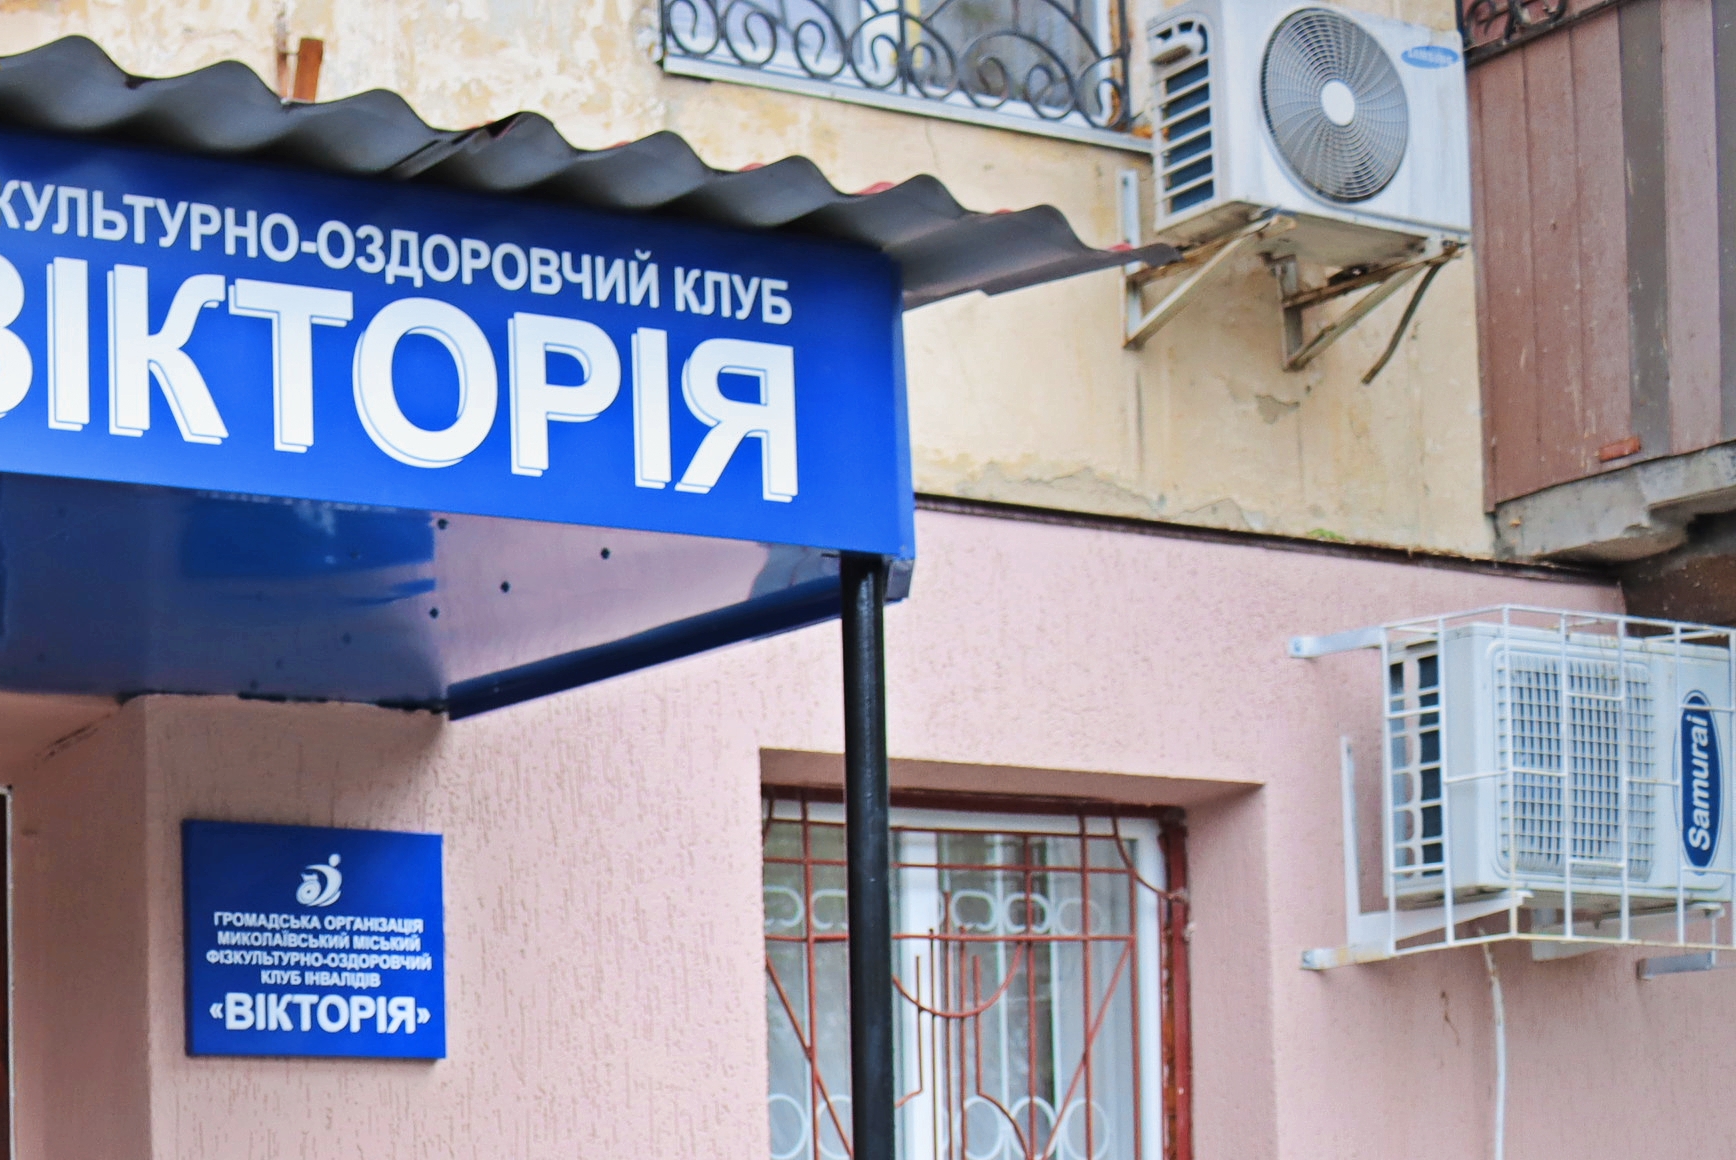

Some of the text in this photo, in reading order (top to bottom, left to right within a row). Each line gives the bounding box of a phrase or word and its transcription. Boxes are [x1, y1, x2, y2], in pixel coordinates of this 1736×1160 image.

[674, 267, 793, 326] КЛУБ
[1686, 714, 1710, 851] Samurai
[214, 911, 424, 934] ГРОМАДСЬКА ОРГАНІЗАЦІЯ
[217, 930, 421, 952] МИКОЛАЇВСЬКИЙ МІСЬКИЙ
[206, 949, 432, 971] ФІЗКУЛЬТУРНО-ОЗДОРОВЧИЙ
[261, 970, 381, 989] КЛУБ ІНВАЛІДІВ
[209, 992, 431, 1034] «ВІКТОРІЯ»
